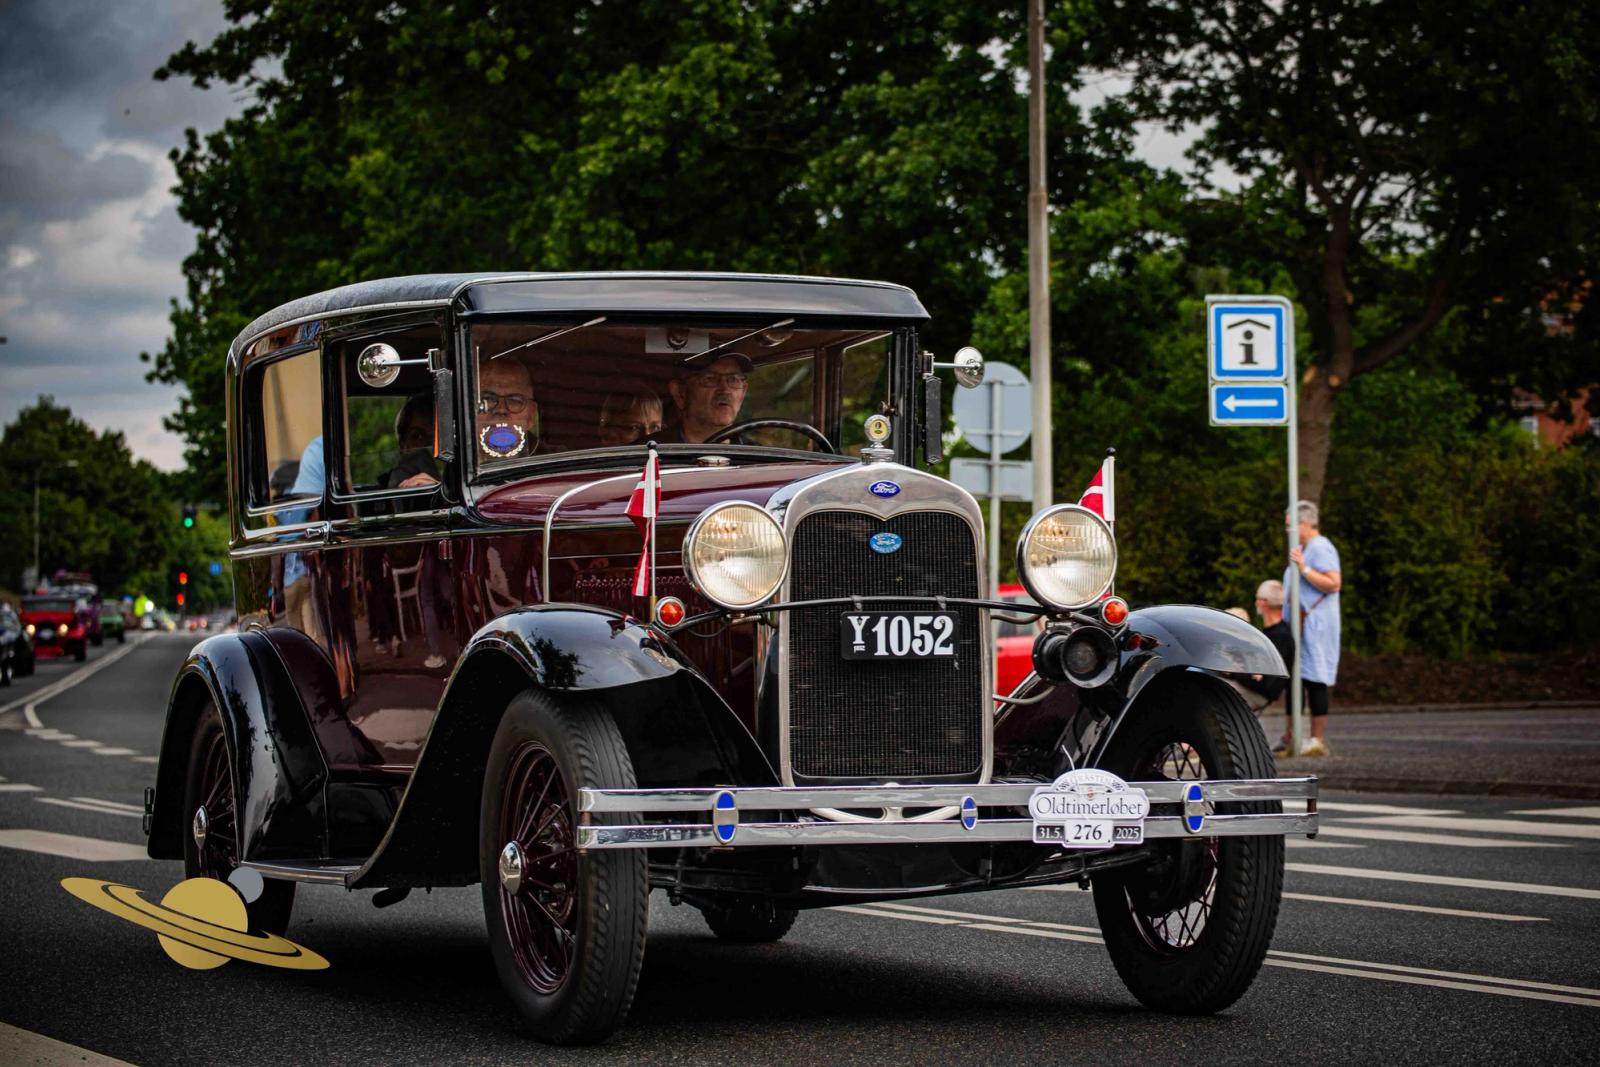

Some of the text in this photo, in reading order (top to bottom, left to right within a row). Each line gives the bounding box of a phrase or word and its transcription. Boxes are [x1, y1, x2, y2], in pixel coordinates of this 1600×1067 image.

[873, 483, 897, 494] Ford
[1036, 797, 1143, 815] Oldtimerløbet
[1039, 827, 1063, 839] 31.5.
[1073, 824, 1102, 841] 276
[1115, 828, 1139, 839] 2025
